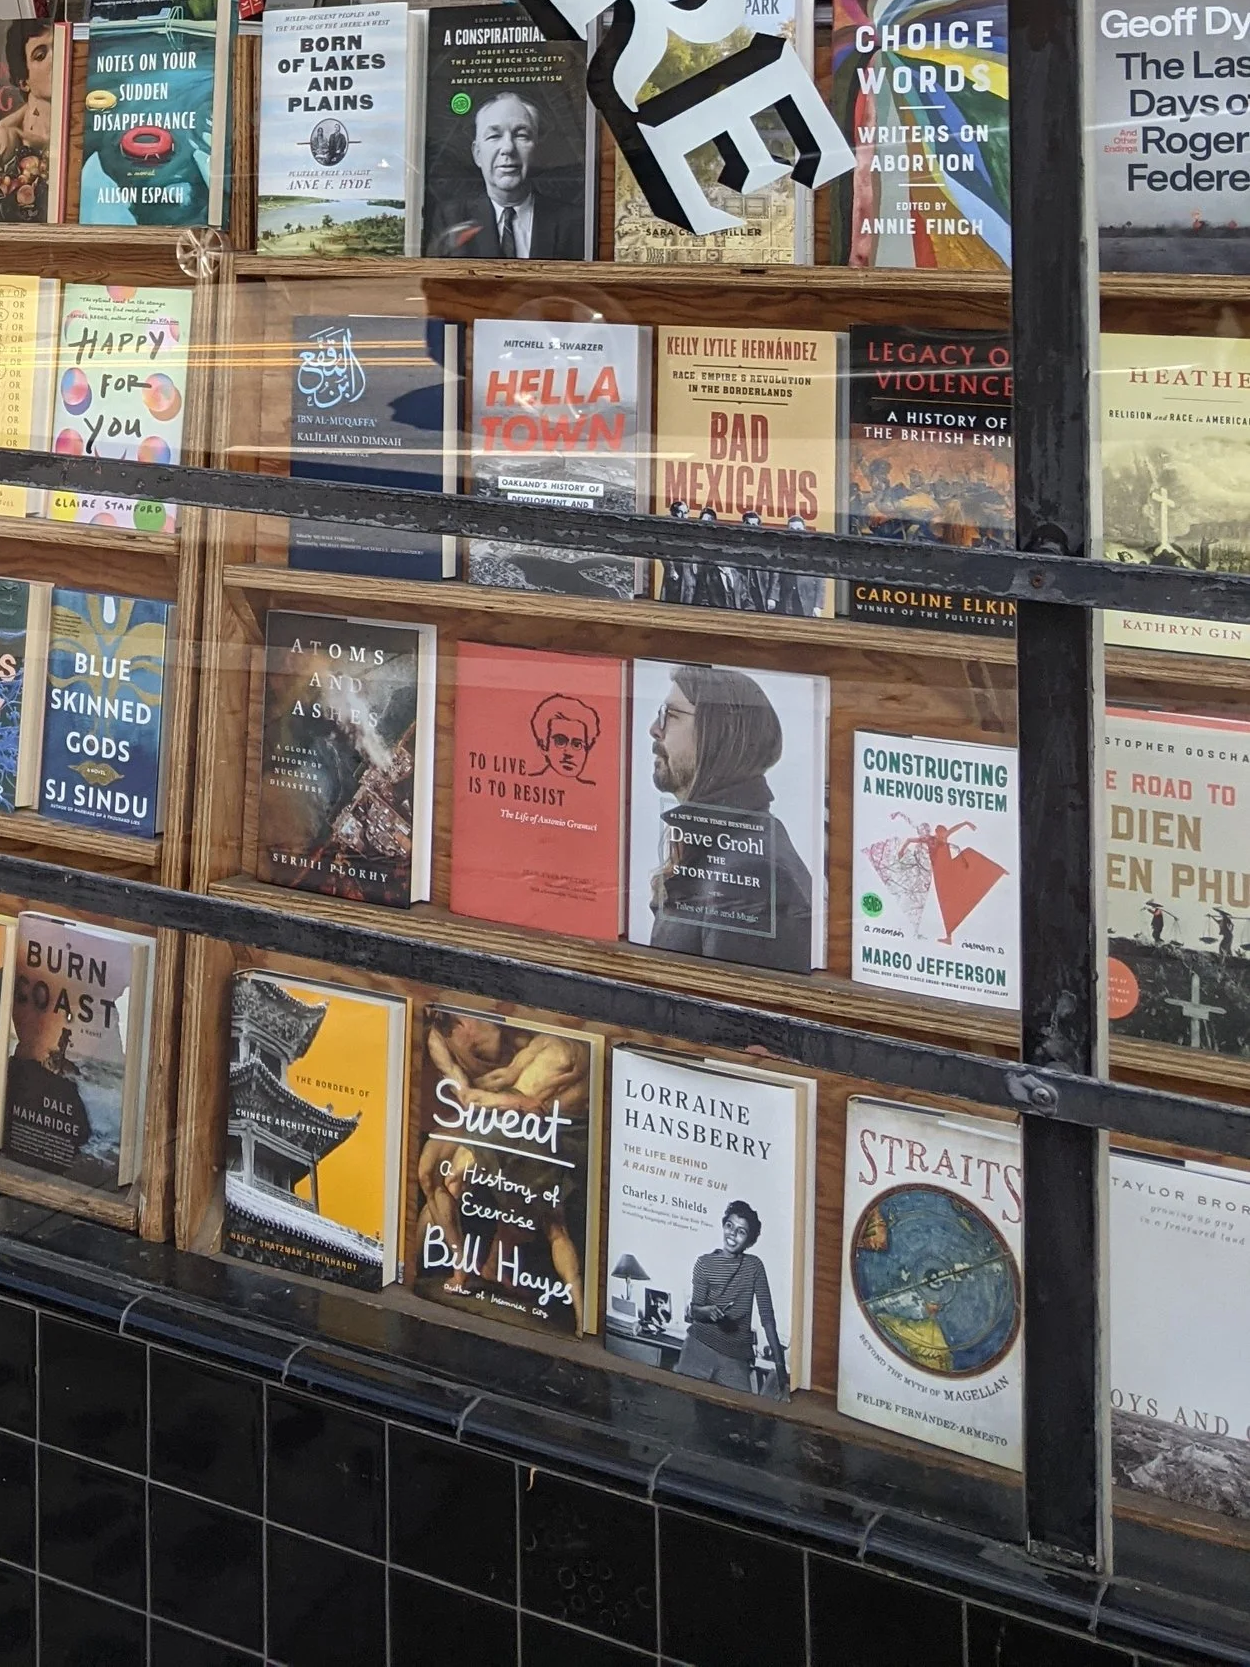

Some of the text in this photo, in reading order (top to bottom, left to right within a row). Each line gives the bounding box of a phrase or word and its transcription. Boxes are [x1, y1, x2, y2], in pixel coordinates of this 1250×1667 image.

[855, 21, 994, 53] CHOICE
[1101, 7, 1198, 39] Geoff
[300, 35, 362, 53] BORN
[97, 52, 196, 72] NOTES ON YOUR
[278, 53, 385, 73] OF LAKES
[1116, 52, 1184, 80] The
[119, 83, 167, 101] SUDDEN
[307, 77, 353, 92] AND
[857, 65, 992, 95] WORDS
[288, 94, 374, 112] PLAINS
[1129, 90, 1218, 122] Days
[93, 112, 196, 131] DISAPPEARANCE
[858, 126, 989, 144] WRITERS ON
[1141, 126, 1245, 160] Roger
[870, 155, 974, 173] ABORTION
[97, 187, 183, 203] ALISON ESPACH
[896, 202, 947, 212] EDITED BY
[861, 219, 983, 235] ANNIE FINCH
[68, 327, 164, 364] HAPPY
[504, 340, 544, 349] MITCHELL
[869, 342, 977, 365] LEGACY
[485, 366, 620, 406] HELLA
[701, 385, 720, 394] THE
[722, 386, 793, 398] BORDERLANDS
[750, 374, 811, 385] REVOLUTION
[480, 414, 625, 451] TOWN
[888, 411, 1007, 429] A HISTORY OF
[710, 411, 769, 464] BAD
[864, 427, 964, 444] THE BRITISH
[501, 478, 547, 489] OAKLAND'S
[551, 481, 584, 492] HISTORY
[665, 461, 817, 519] MEXICANS
[55, 498, 162, 514] CLAIRE STANFORD
[1122, 620, 1242, 640] KATHRYN GIN
[291, 638, 384, 665] ATOMS
[75, 653, 131, 681] BLUE
[51, 690, 151, 724] SKINNED
[66, 732, 130, 762] GODS
[863, 748, 1008, 788] CONSTRUCTING
[46, 779, 147, 818] SJ SINDU
[1132, 773, 1235, 806] ROAD TO
[669, 826, 764, 855] Dave Grohl
[1111, 804, 1201, 852] DIEN
[707, 855, 726, 864] THE
[672, 866, 760, 888] STORYTELLER
[27, 941, 107, 988] BURN
[862, 946, 912, 969] MARGO
[916, 956, 1006, 987] JEFFERSON
[44, 1097, 73, 1116] DALE
[433, 1079, 572, 1152] Sweat
[625, 1079, 750, 1125] LORRAINE
[13, 1105, 79, 1136] MAHARIDGE
[624, 1109, 772, 1160] HANSBERRY
[623, 1144, 708, 1170] THE LIFE BEHIND
[859, 1129, 1021, 1224] STRAITS
[230, 1233, 357, 1271] NANCY SHATZMAN STEINHARDT
[423, 1223, 573, 1306] Bill Hayes
